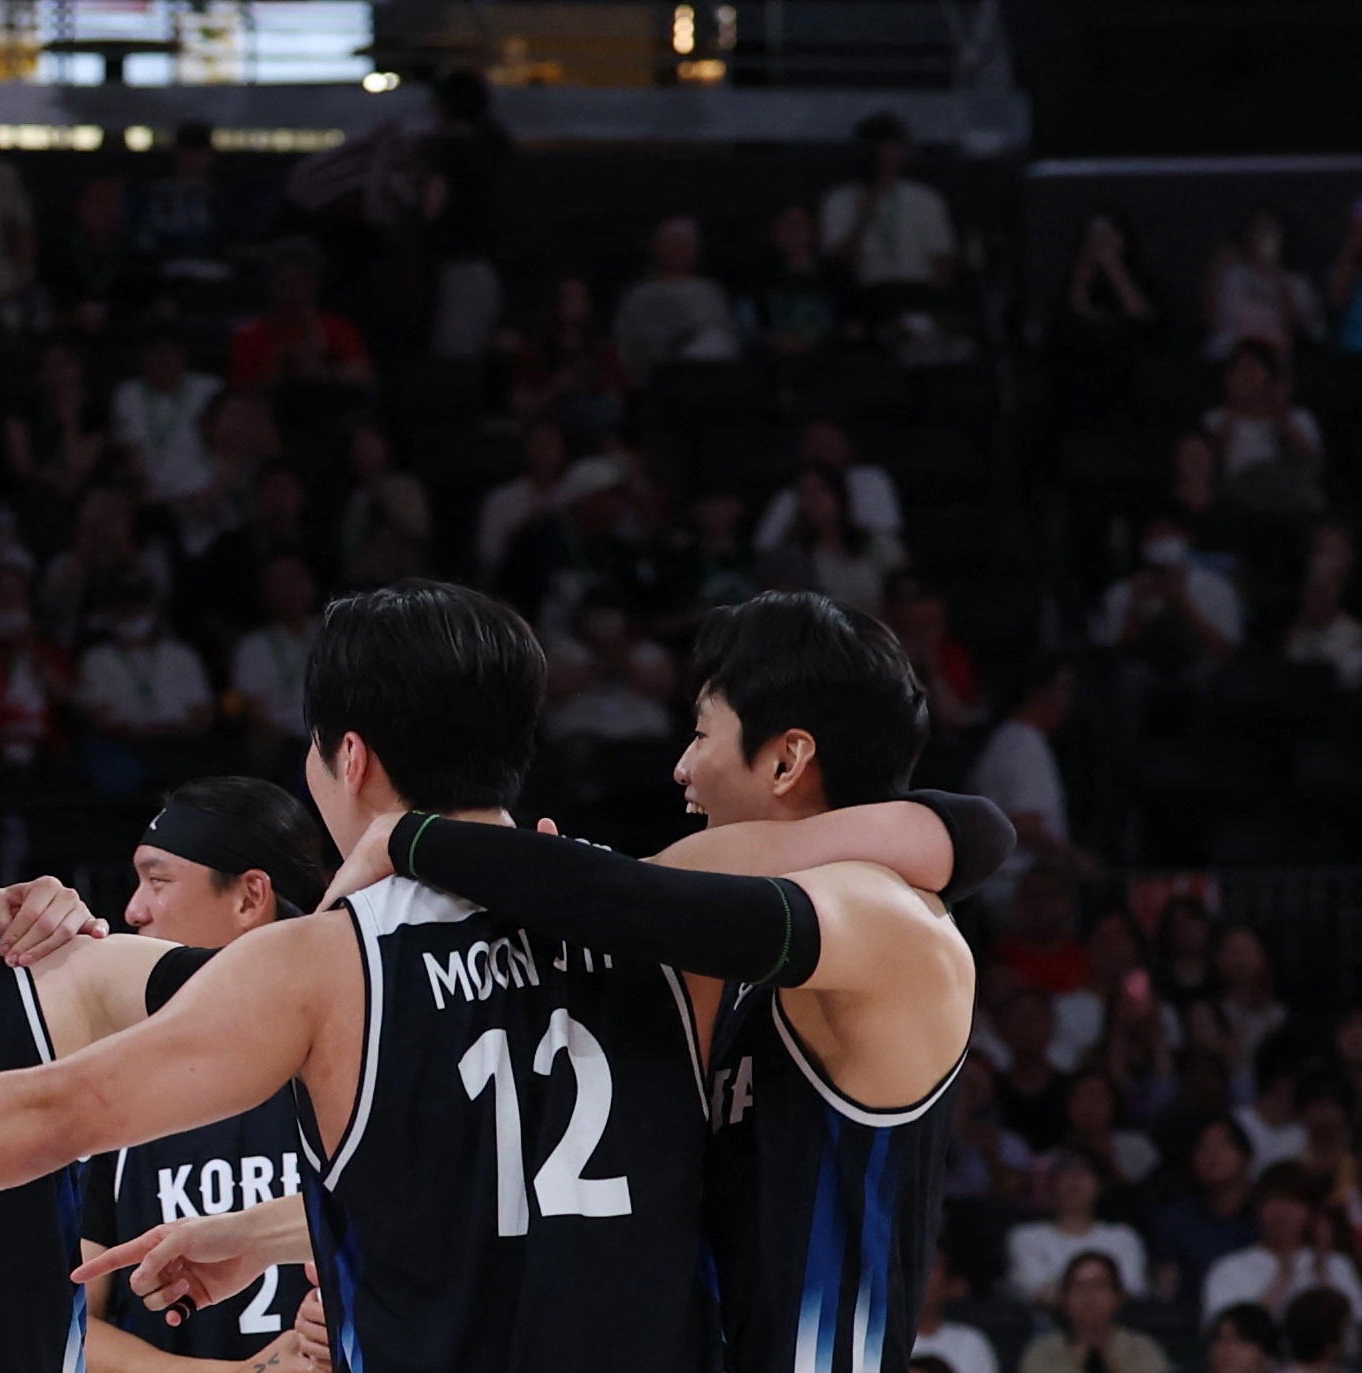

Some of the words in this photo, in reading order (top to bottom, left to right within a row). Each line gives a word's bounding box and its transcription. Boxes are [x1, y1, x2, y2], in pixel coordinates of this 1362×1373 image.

[422, 928, 540, 1009] MOON
[458, 1008, 632, 1237] 12
[238, 1264, 282, 1335] 2
